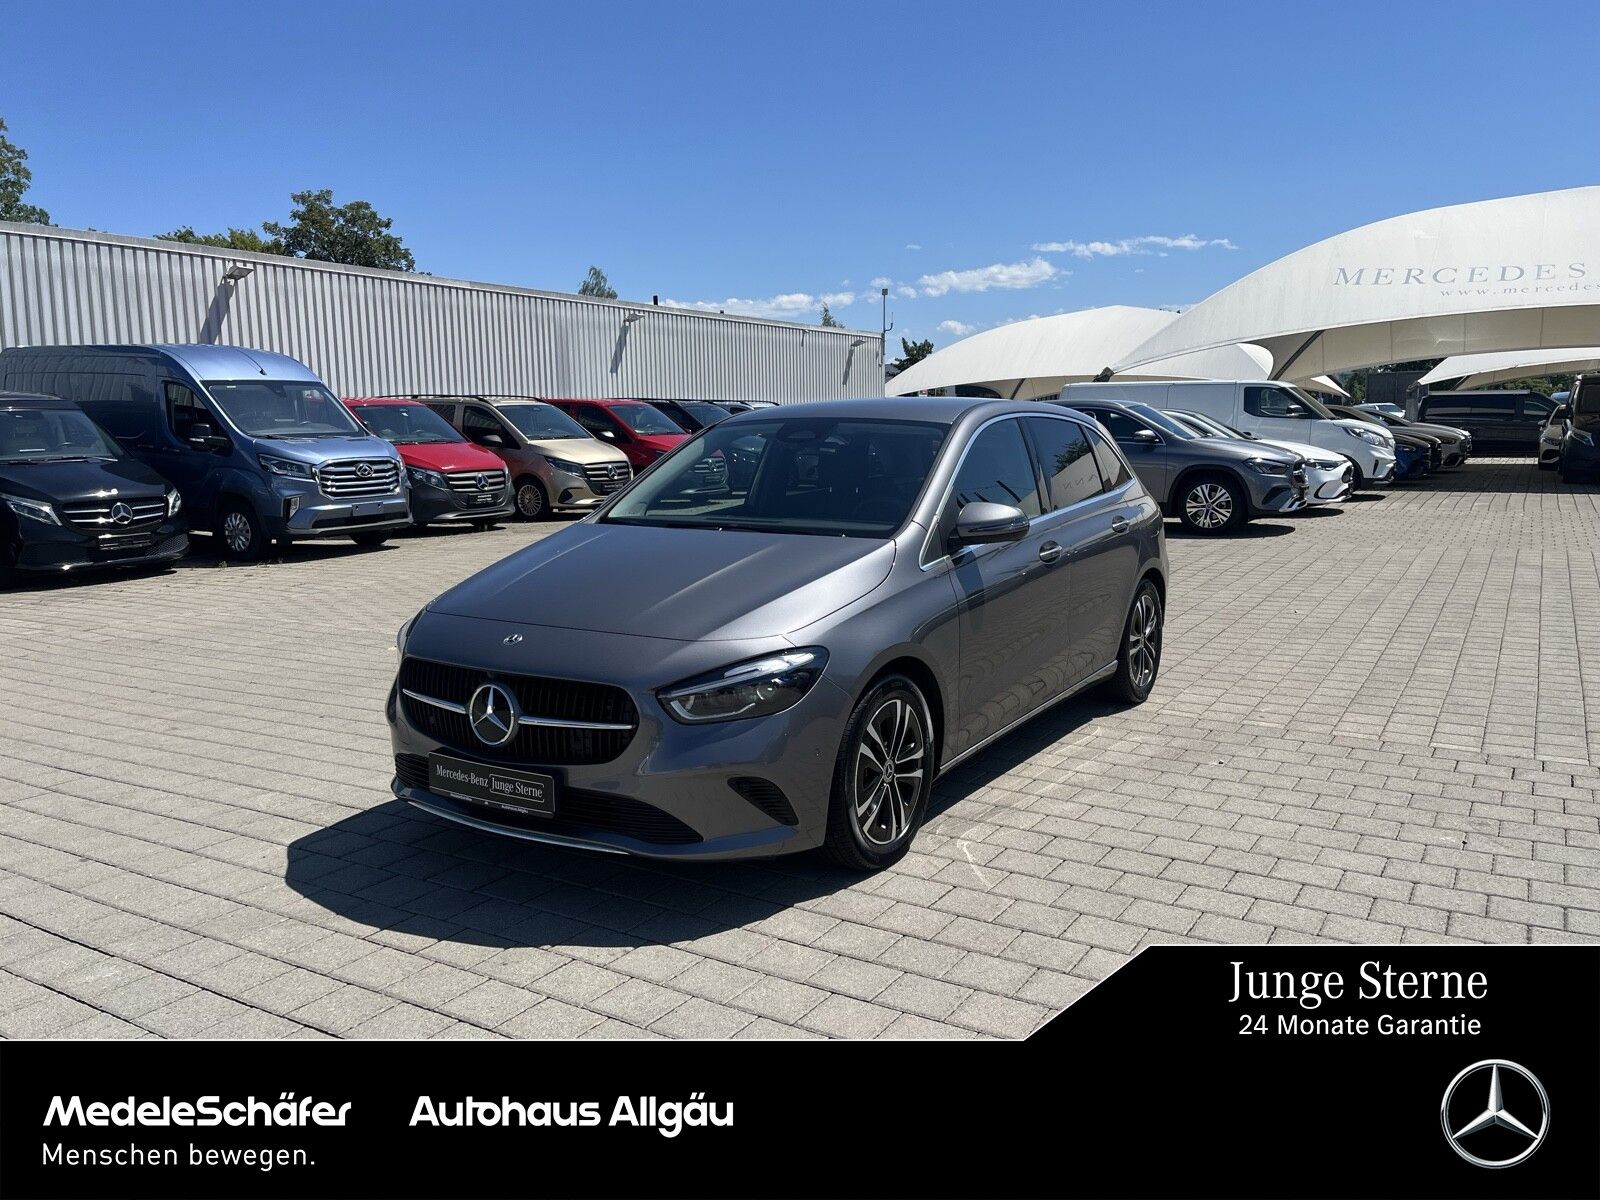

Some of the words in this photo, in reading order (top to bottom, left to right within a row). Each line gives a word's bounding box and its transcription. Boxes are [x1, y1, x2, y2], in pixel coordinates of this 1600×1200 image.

[1333, 262, 1586, 286] MERCEDES
[436, 764, 489, 788] Mercedes-Benz
[491, 777, 514, 794] Junge
[515, 783, 543, 798] Sterne
